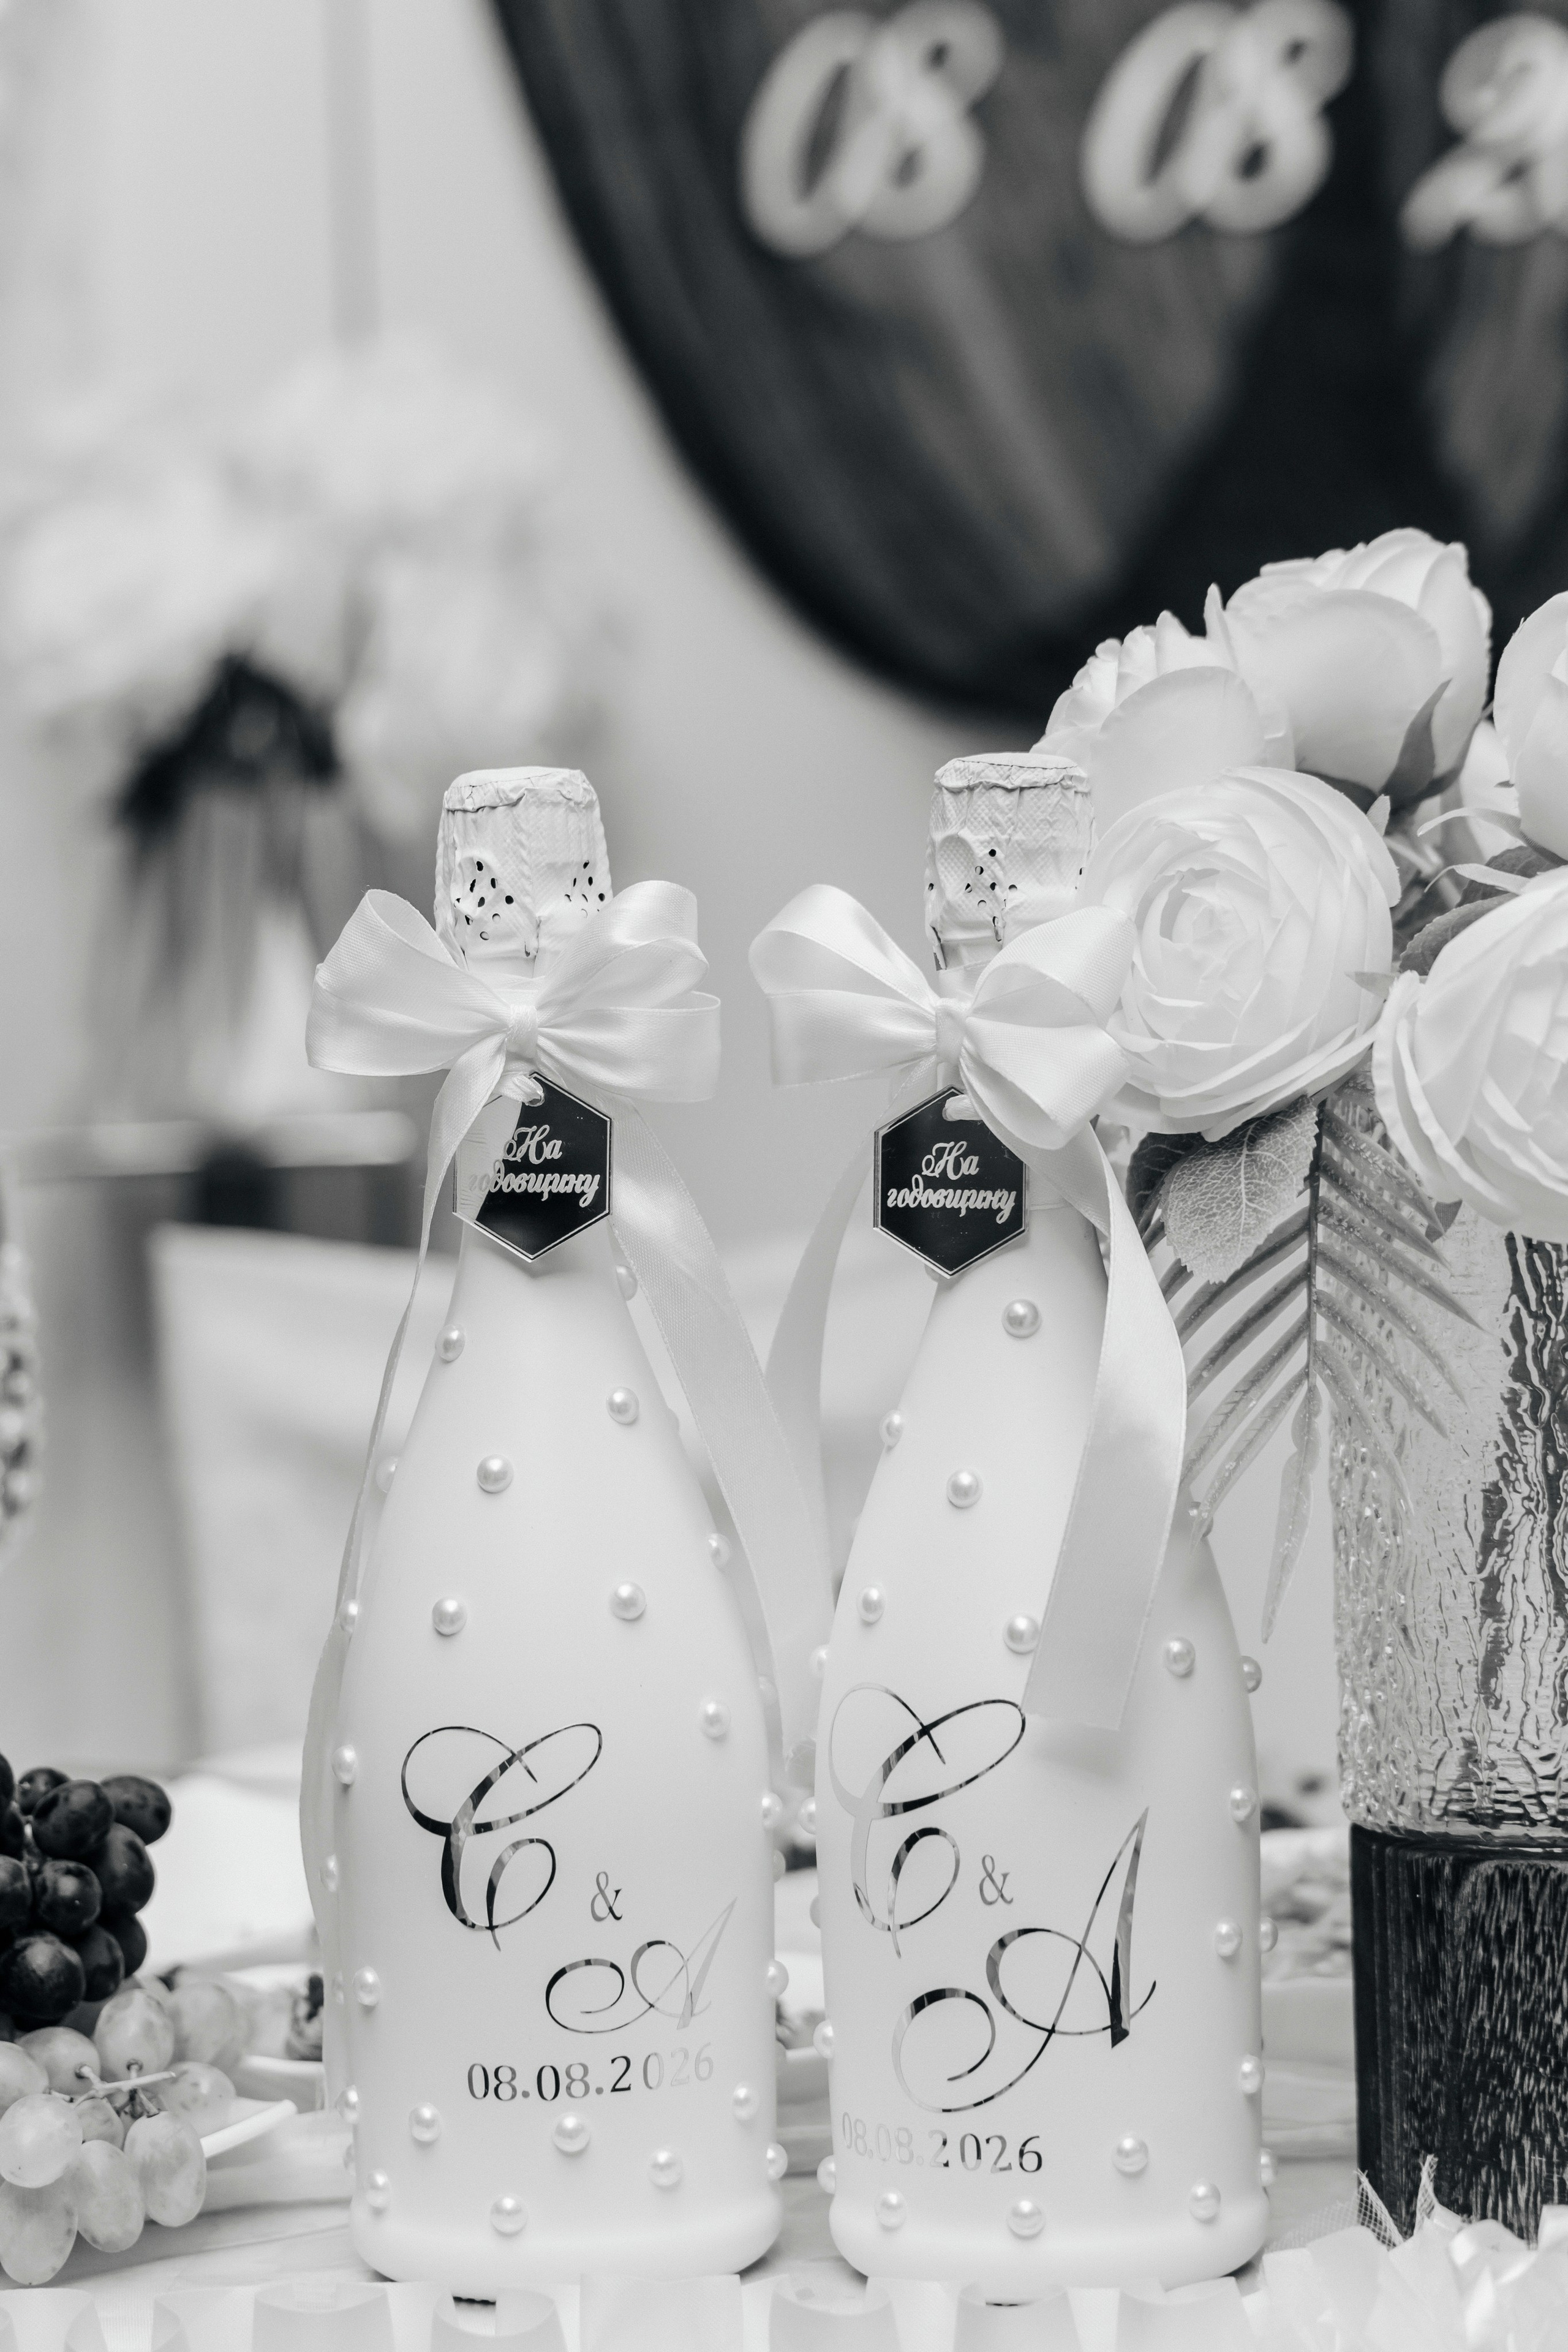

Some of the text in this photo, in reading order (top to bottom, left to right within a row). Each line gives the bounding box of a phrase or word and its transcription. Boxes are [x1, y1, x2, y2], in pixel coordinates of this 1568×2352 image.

[503, 1125, 563, 1164] На
[921, 1140, 980, 1180] На
[887, 1174, 1017, 1224] годовщину
[590, 1871, 624, 1922] &
[979, 1854, 1014, 1905] &
[467, 2042, 714, 2101] 08.08.2026
[842, 2111, 1043, 2173] 08.08.2026
